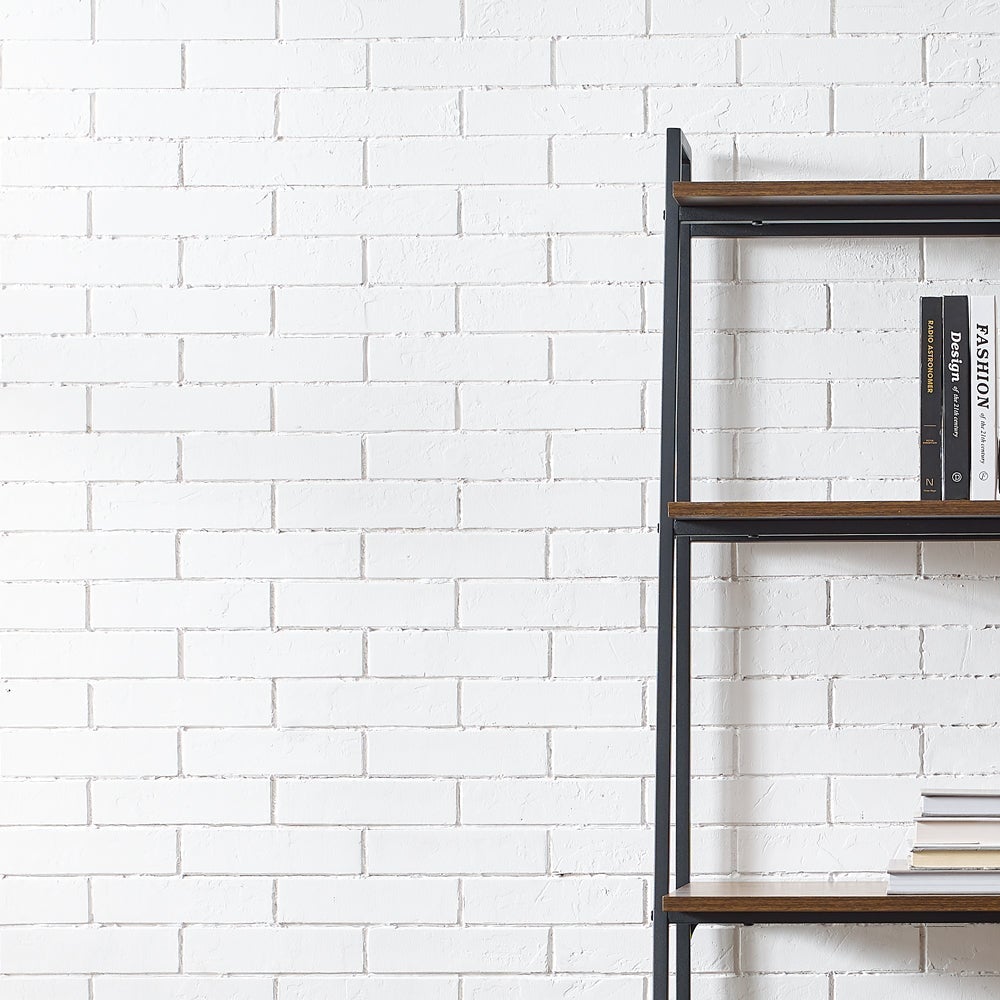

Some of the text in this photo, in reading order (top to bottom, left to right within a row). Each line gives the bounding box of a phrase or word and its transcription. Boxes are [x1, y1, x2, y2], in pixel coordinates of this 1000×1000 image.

[948, 330, 963, 382] Design
[976, 323, 989, 409] FASHION
[952, 385, 960, 393] of
[979, 412, 986, 420] of
